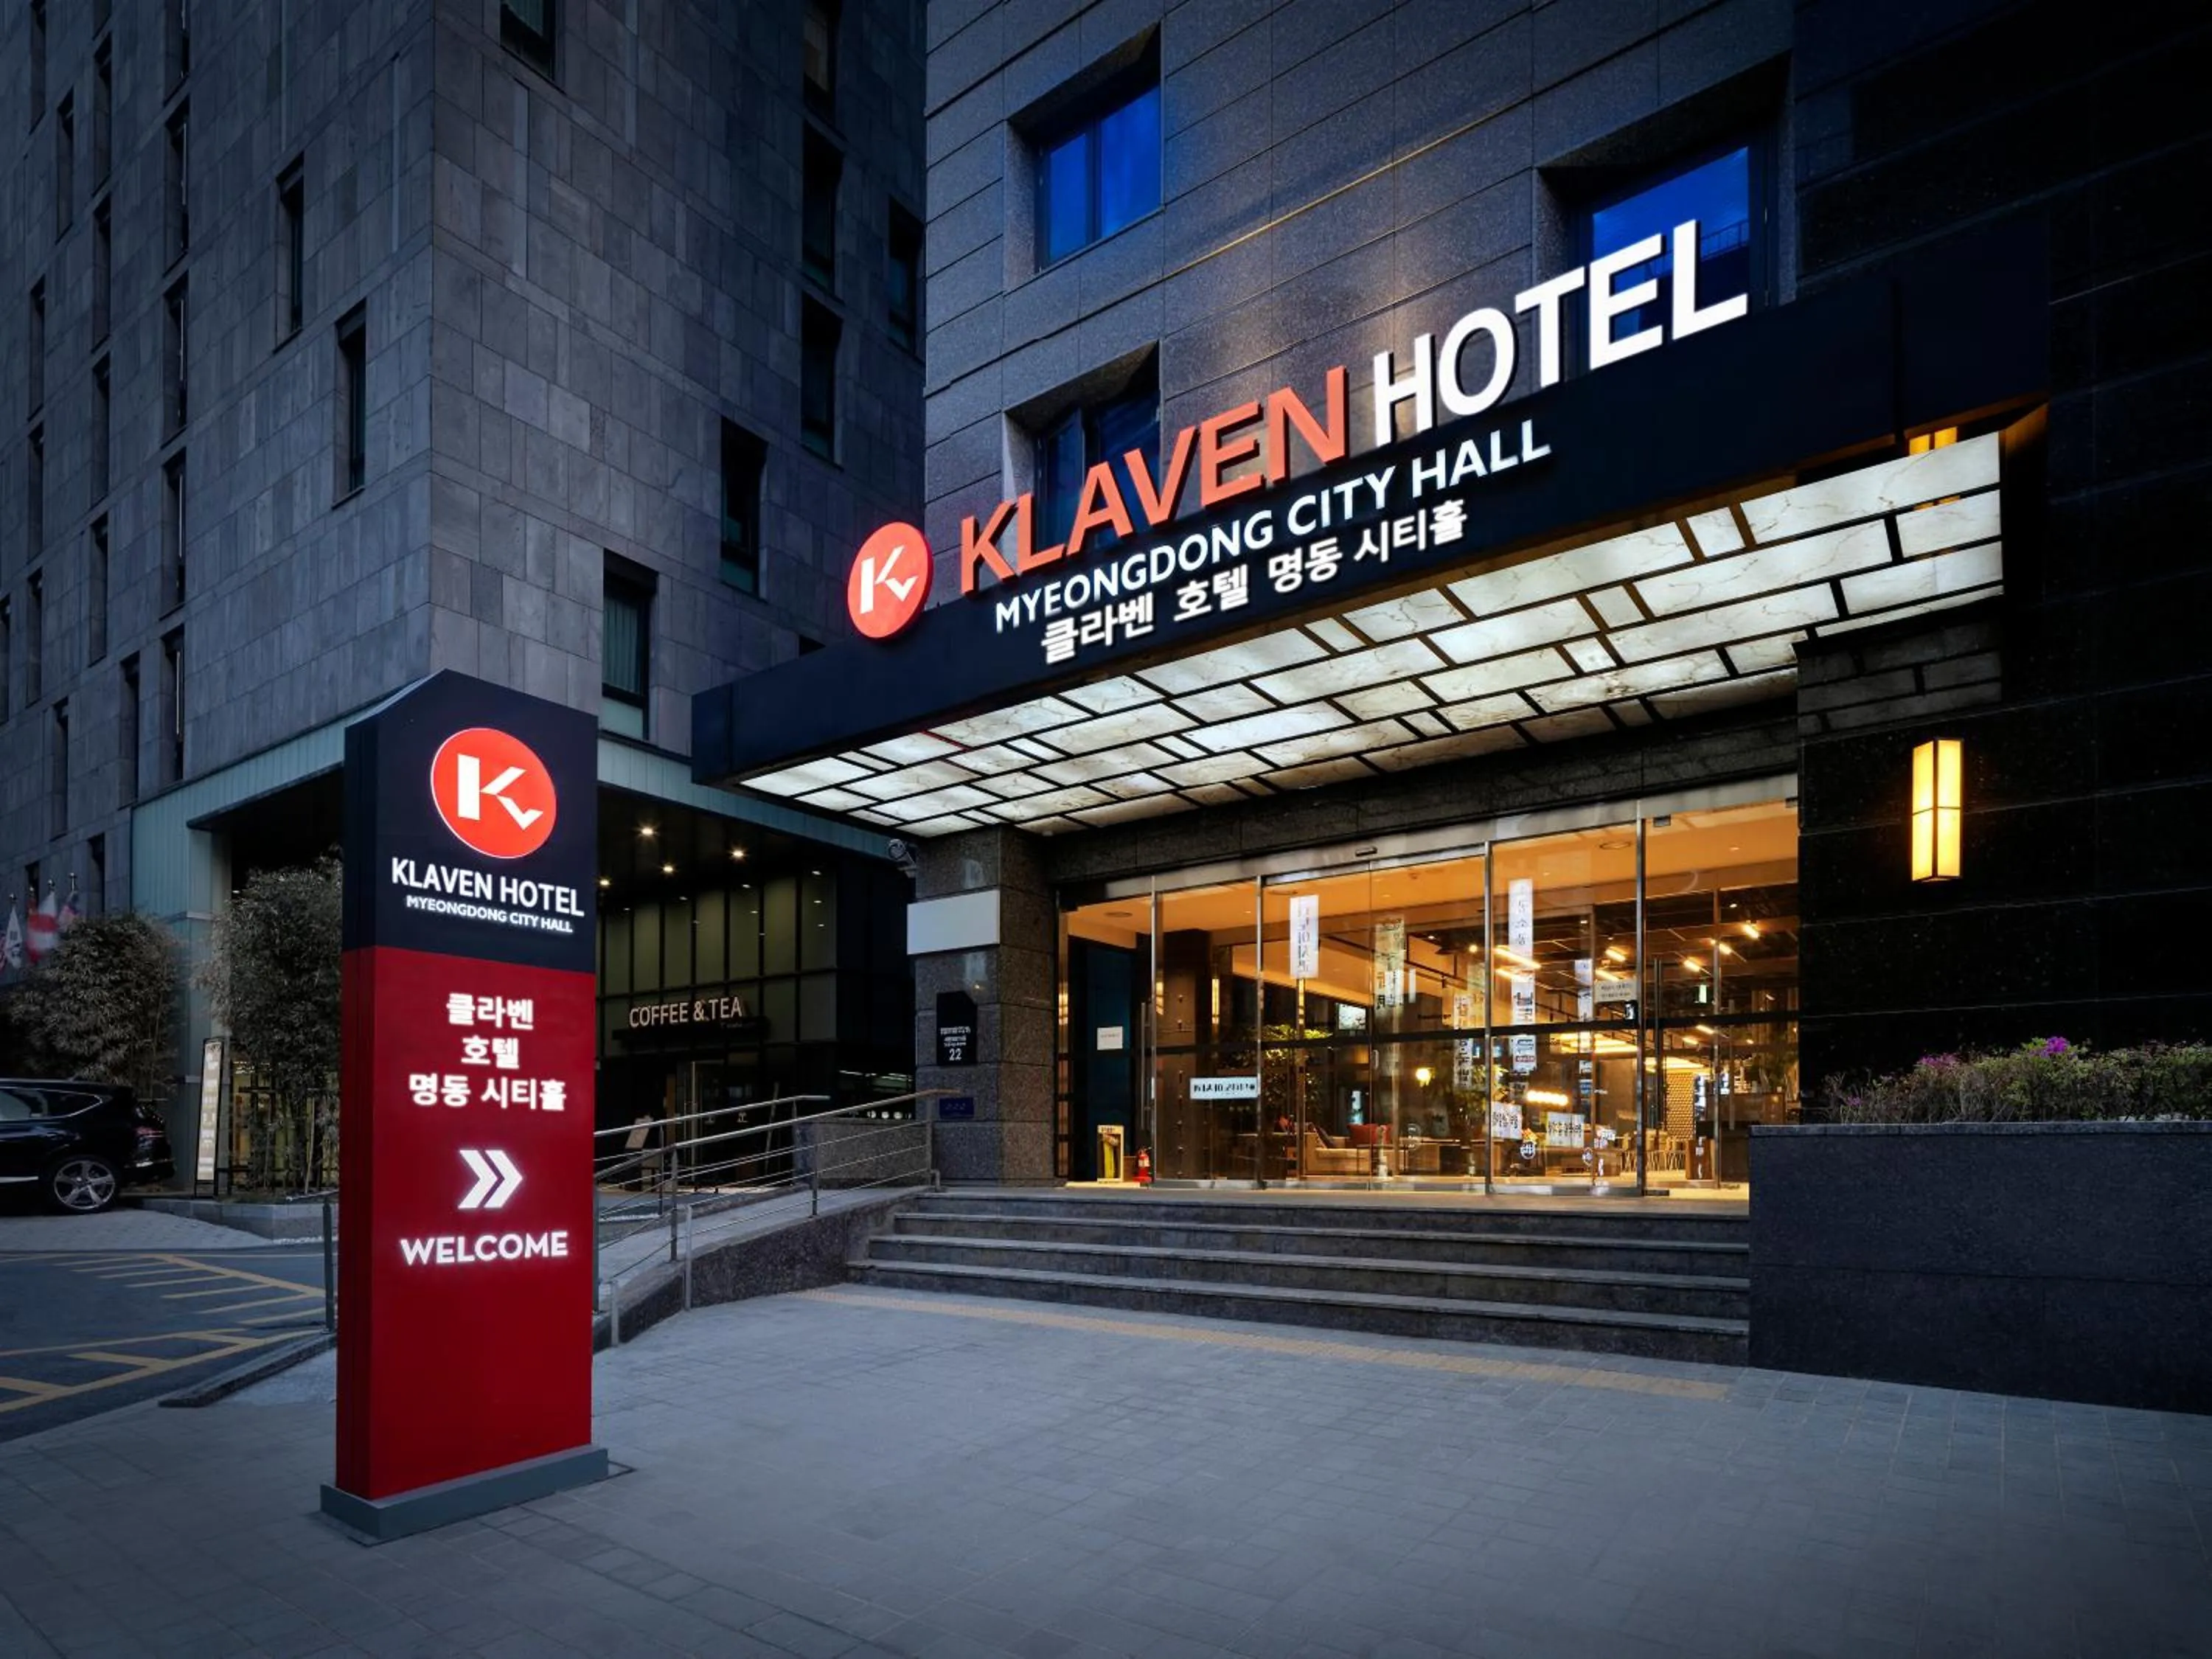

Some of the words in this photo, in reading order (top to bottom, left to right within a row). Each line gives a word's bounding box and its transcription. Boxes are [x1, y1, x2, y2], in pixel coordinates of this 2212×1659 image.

[961, 366, 1347, 595] KLAVEN
[1373, 219, 1748, 448] HOTEL
[995, 509, 1274, 633] MYEONGDONG
[1287, 465, 1397, 536] CITY
[1411, 419, 1551, 498] HALL
[1040, 592, 1155, 664] 클라벤
[1172, 564, 1250, 622] 호텔
[1267, 538, 1343, 594] 명동
[1353, 498, 1469, 563] 시티홀
[391, 856, 493, 900] KLAVEN
[499, 875, 585, 917] HOTEL
[406, 894, 507, 922] MYEONGDONG
[509, 911, 539, 929] CITY
[540, 917, 574, 933] HALL
[446, 992, 535, 1030] 클라벤
[629, 1002, 689, 1028] COFFEE
[693, 1000, 709, 1021] &
[709, 996, 743, 1020] TEA
[461, 1034, 521, 1069] 호텔
[949, 1048, 961, 1061] 22
[408, 1073, 471, 1107] 명동
[480, 1077, 567, 1111] 시티홀
[400, 1230, 568, 1267] WELCOME
